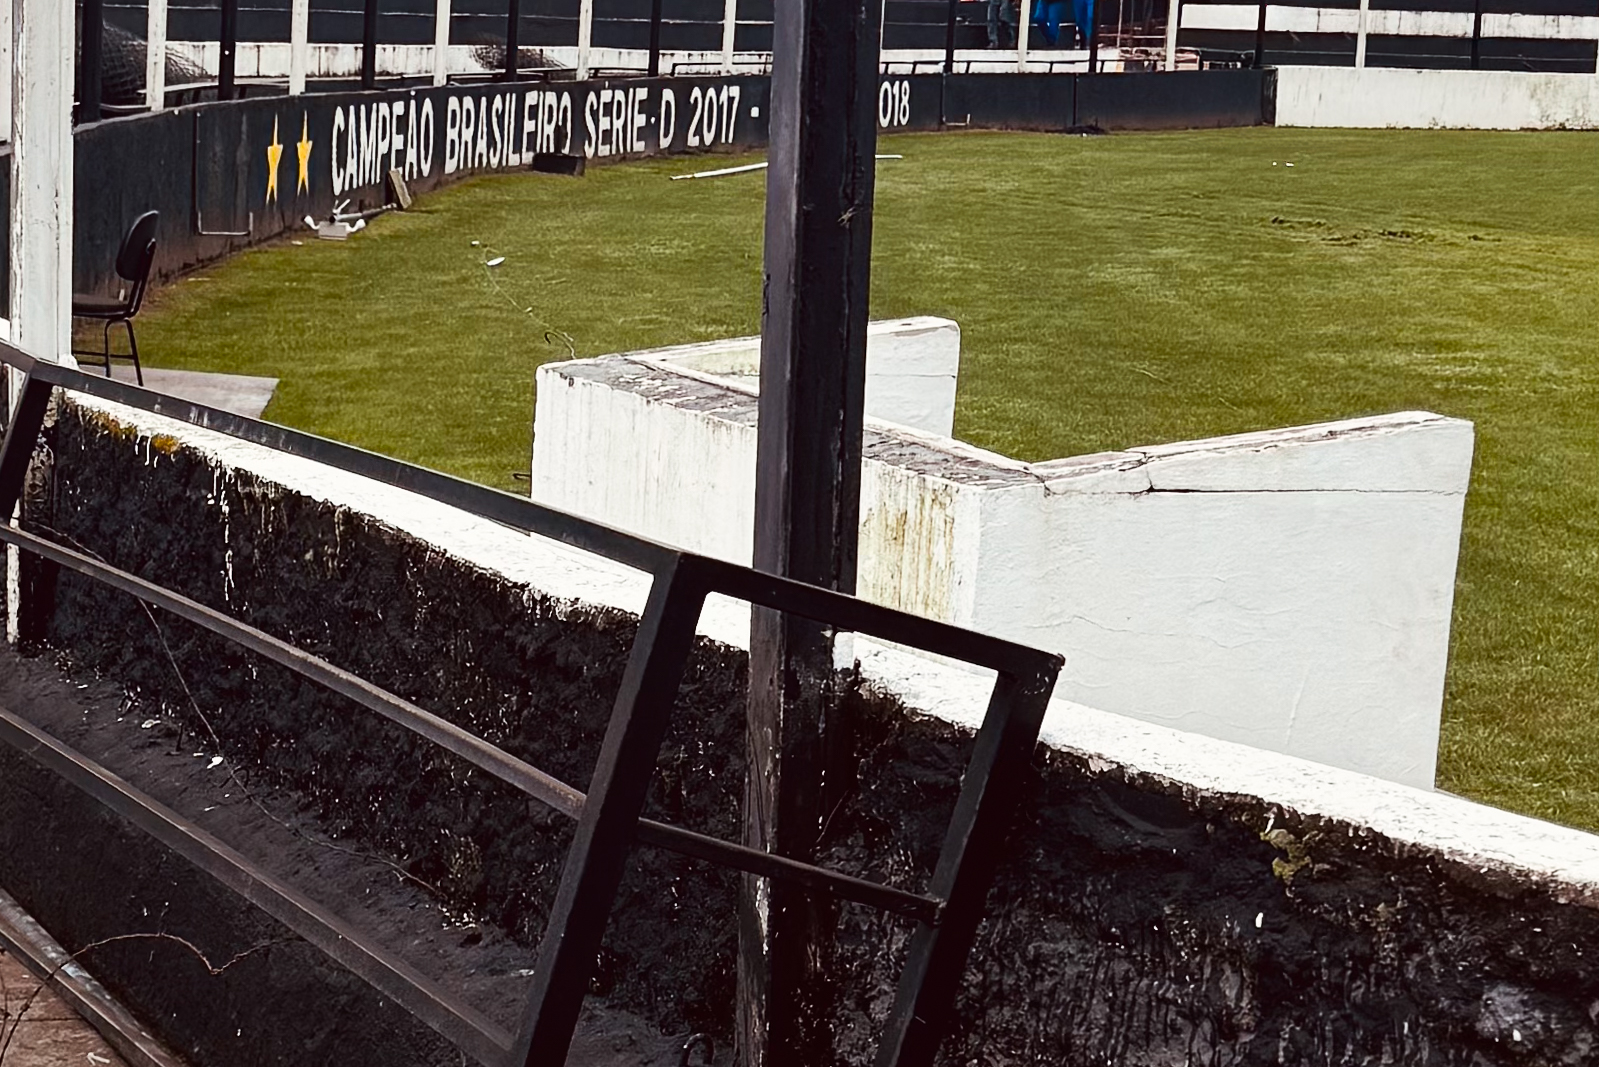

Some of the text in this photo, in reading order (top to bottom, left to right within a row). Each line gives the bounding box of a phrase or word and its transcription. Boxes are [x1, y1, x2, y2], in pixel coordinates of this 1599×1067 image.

[444, 90, 572, 175] BRASILEIRO
[659, 88, 676, 150] D
[687, 84, 741, 147] 2017
[878, 80, 910, 128] 018
